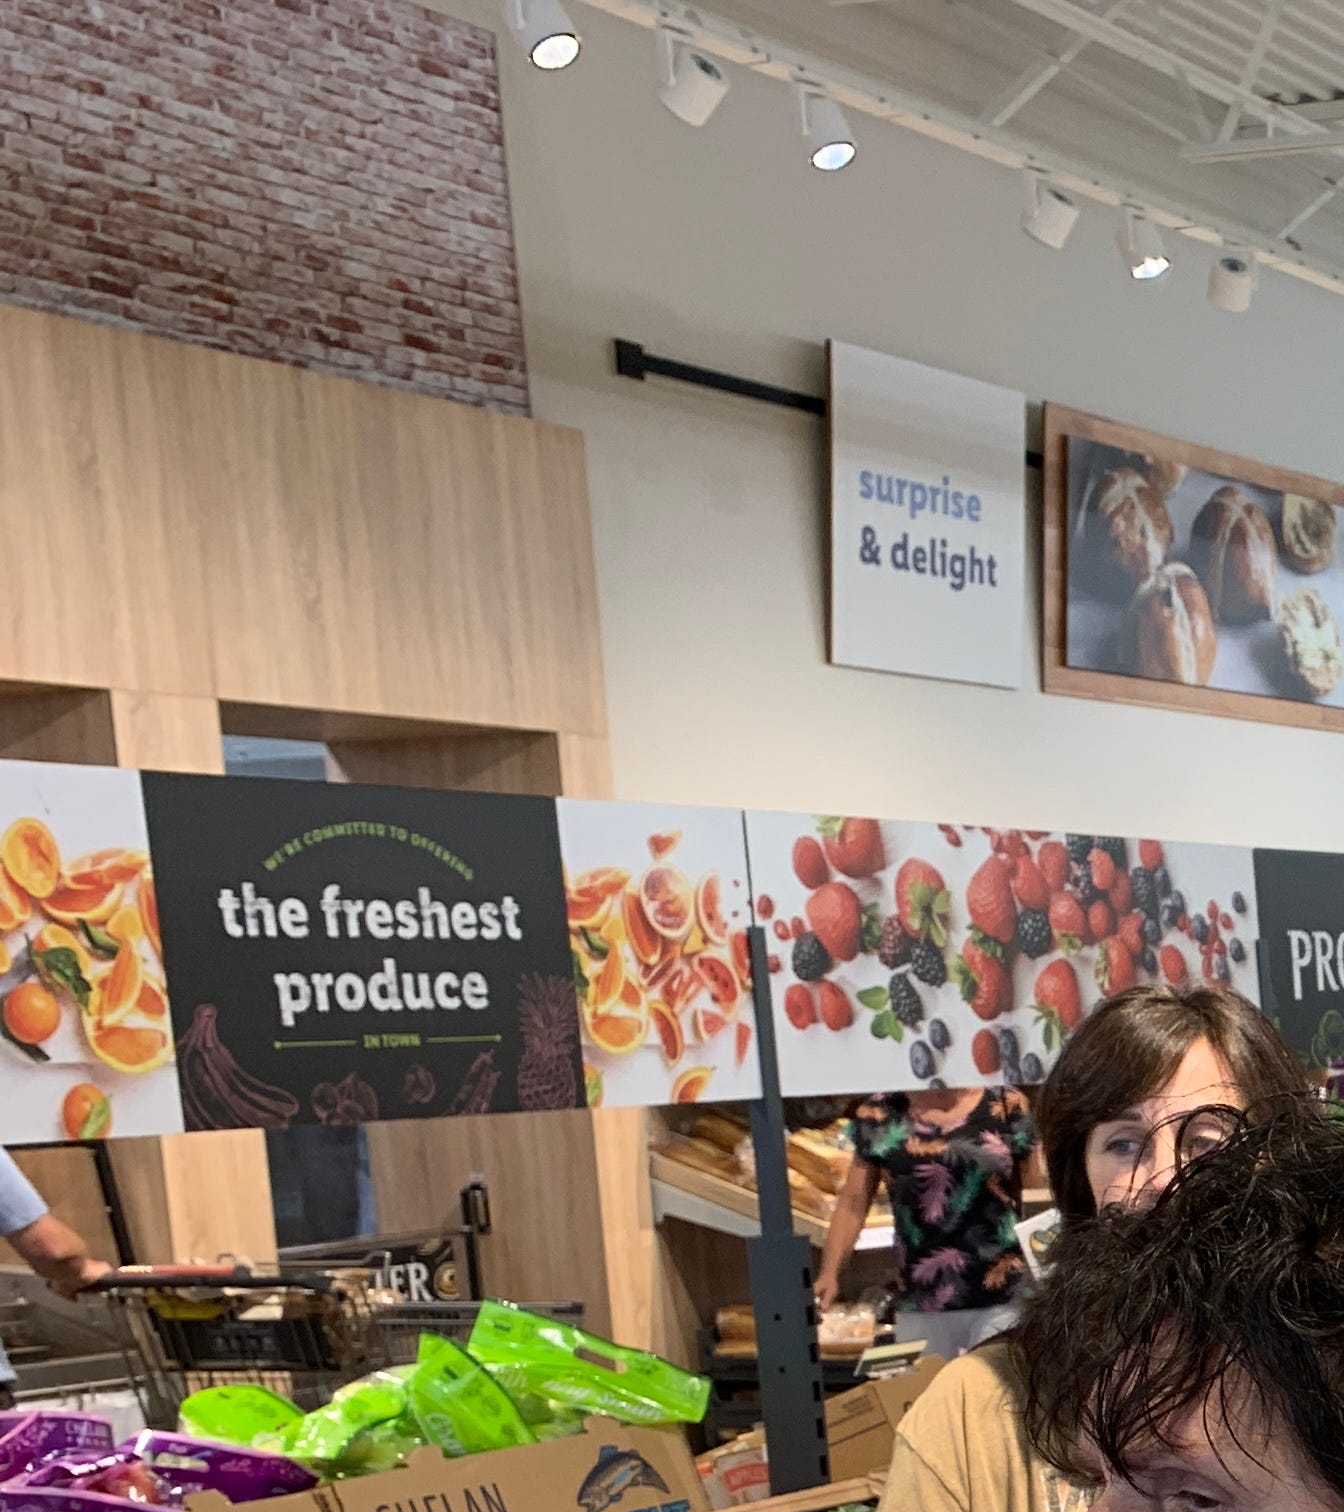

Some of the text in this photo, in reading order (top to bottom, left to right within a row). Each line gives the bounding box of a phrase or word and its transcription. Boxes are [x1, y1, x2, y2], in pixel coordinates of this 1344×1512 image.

[858, 469, 982, 522] surprise
[858, 526, 997, 591] & delight
[303, 821, 385, 847] COMMITTED
[390, 826, 408, 841] TO
[218, 882, 522, 940] the freshest
[274, 958, 489, 1027] produce
[363, 1033, 421, 1049] IN TOWN
